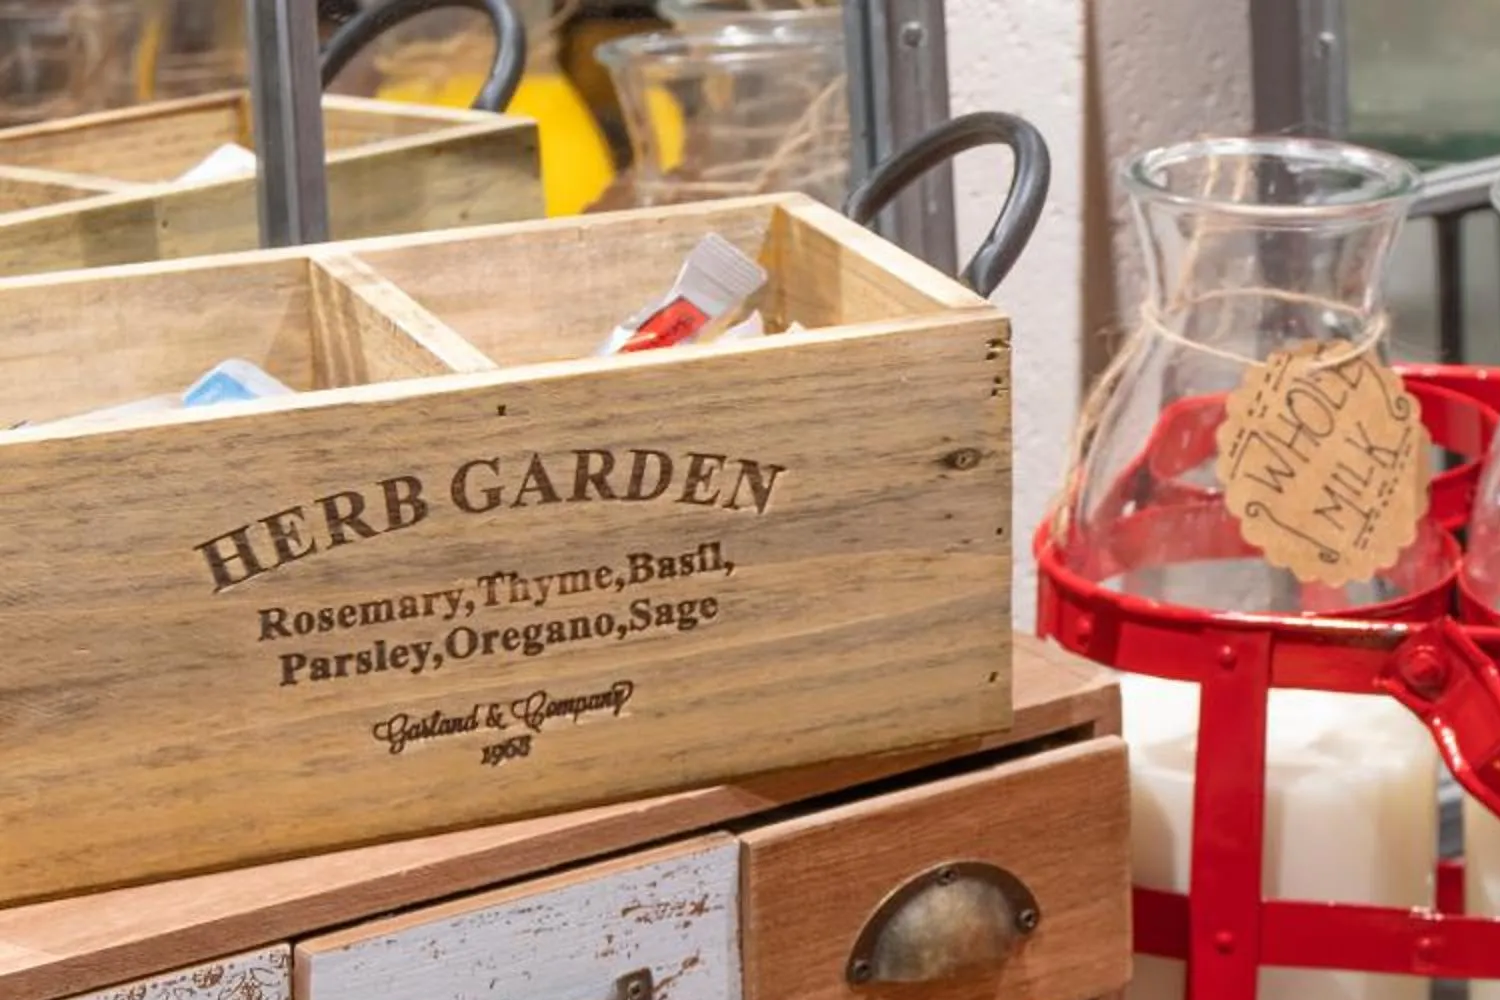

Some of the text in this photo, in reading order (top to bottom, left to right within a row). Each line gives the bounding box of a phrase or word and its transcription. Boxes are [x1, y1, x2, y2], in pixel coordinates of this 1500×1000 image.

[1243, 355, 1364, 495] WHOLE
[1312, 420, 1400, 532] MILK
[193, 449, 787, 594] HERB GARDEN
[485, 704, 507, 730] &
[511, 680, 634, 734] Company
